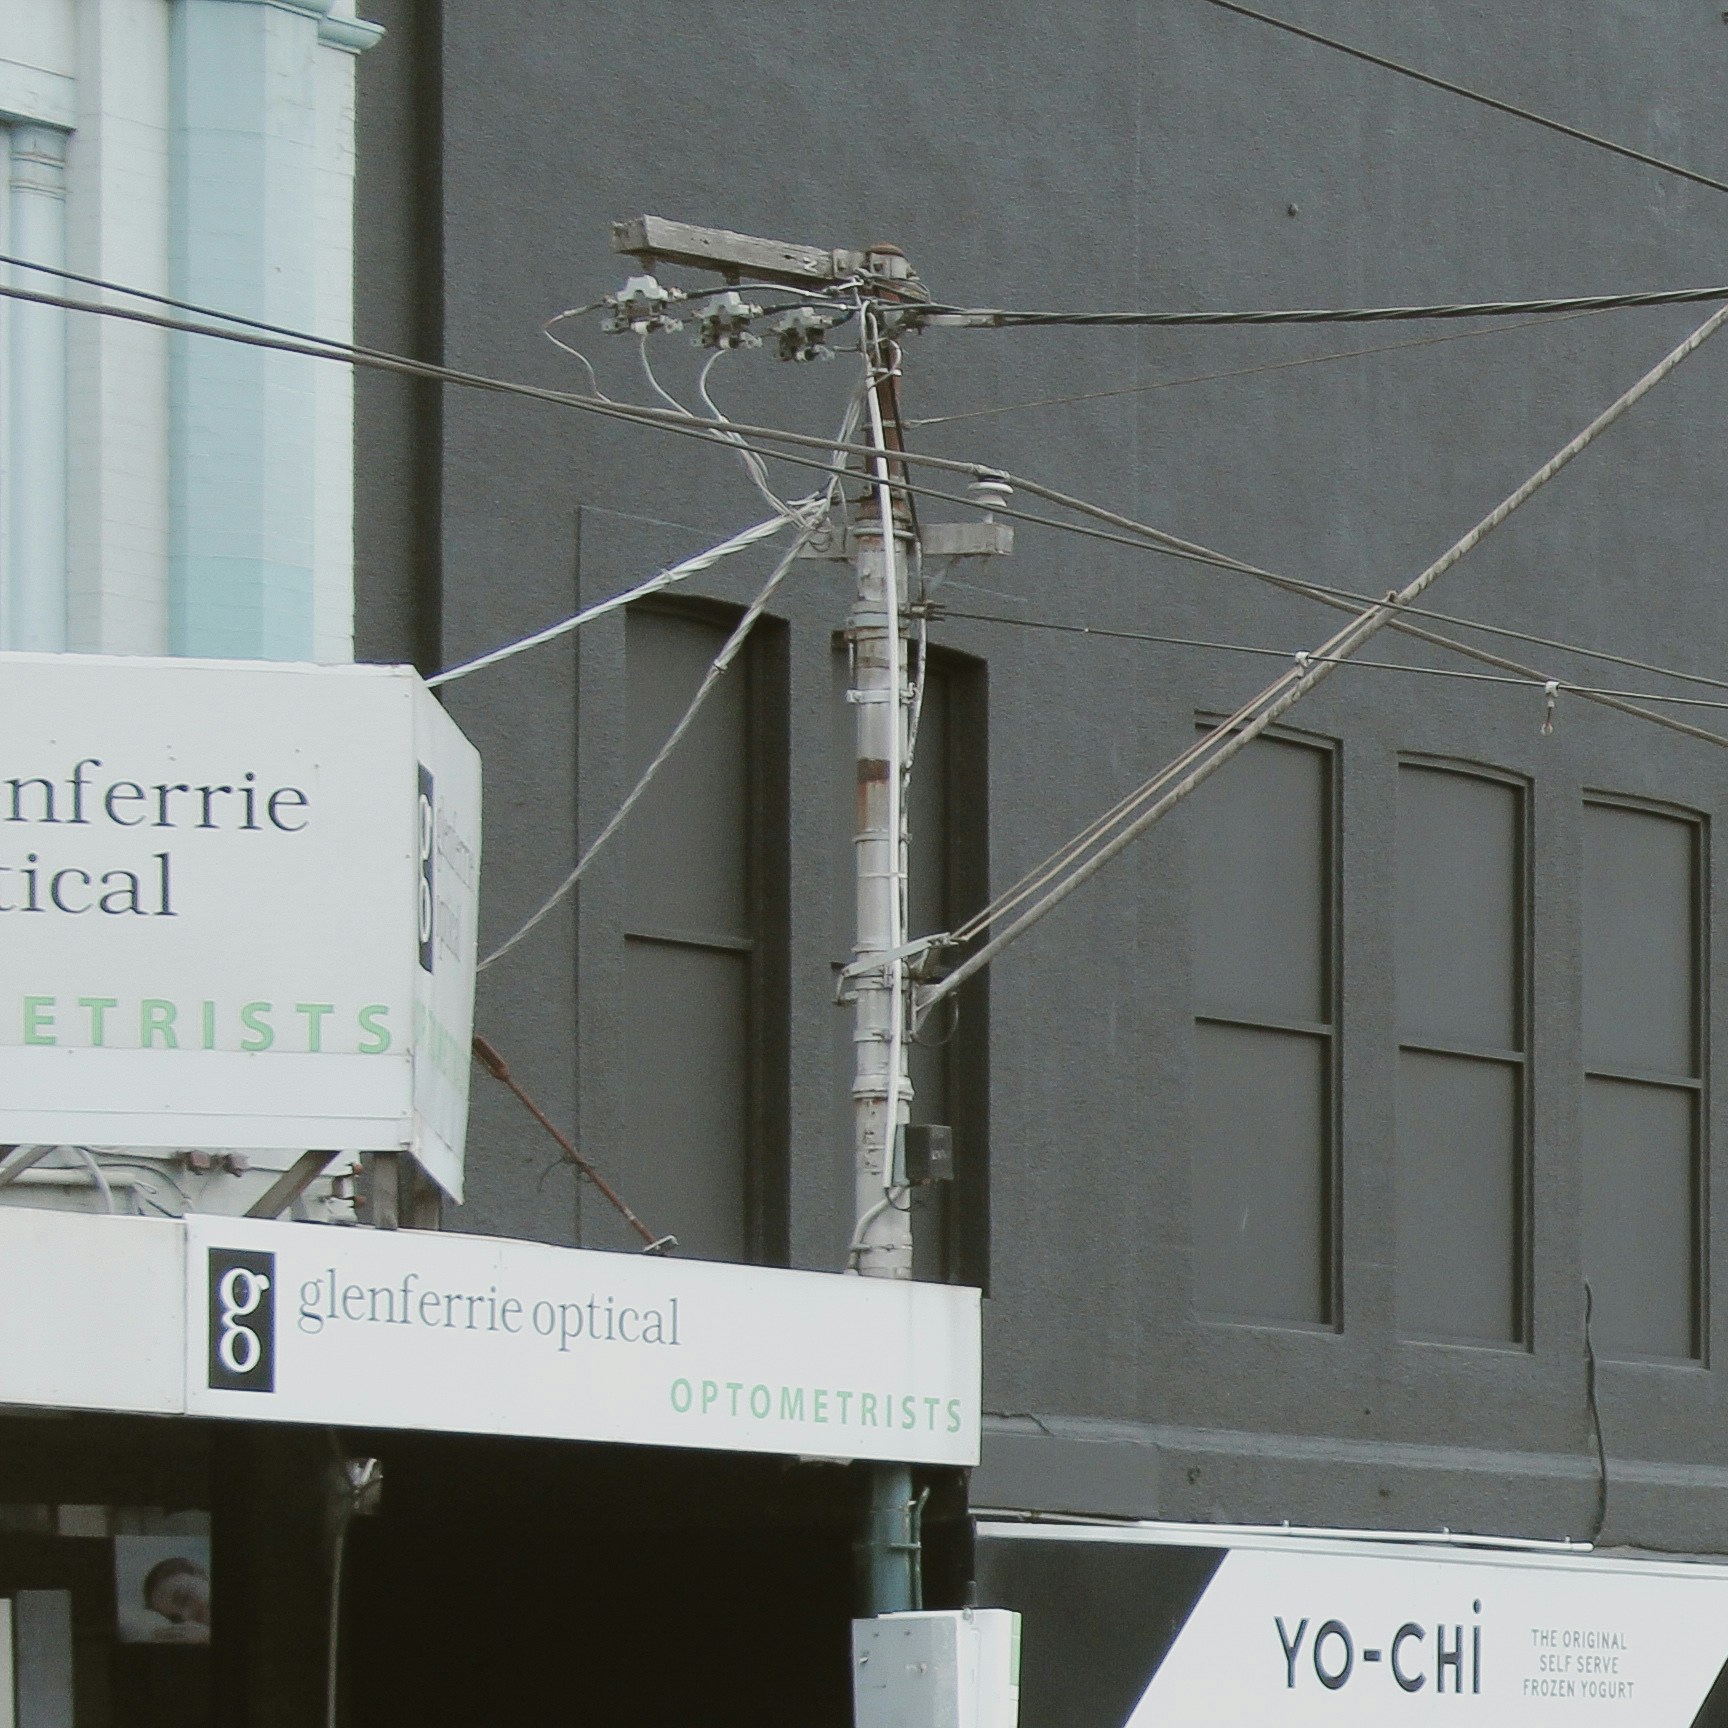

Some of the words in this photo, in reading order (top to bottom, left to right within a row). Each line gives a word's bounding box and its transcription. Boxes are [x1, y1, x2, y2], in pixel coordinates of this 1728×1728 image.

[3, 757, 311, 832] nferrie
[297, 1268, 524, 1334] glenferrie
[533, 1296, 681, 1353] optical
[669, 1376, 963, 1436] OPTOMETRISTS
[1531, 1628, 1558, 1648] THE
[1562, 1630, 1628, 1651] ORIGINAL
[1539, 1653, 1572, 1673] SELF
[1576, 1655, 1619, 1675] SERVE
[1522, 1677, 1576, 1698] FROZEN
[1579, 1679, 1635, 1699] YOGURT
